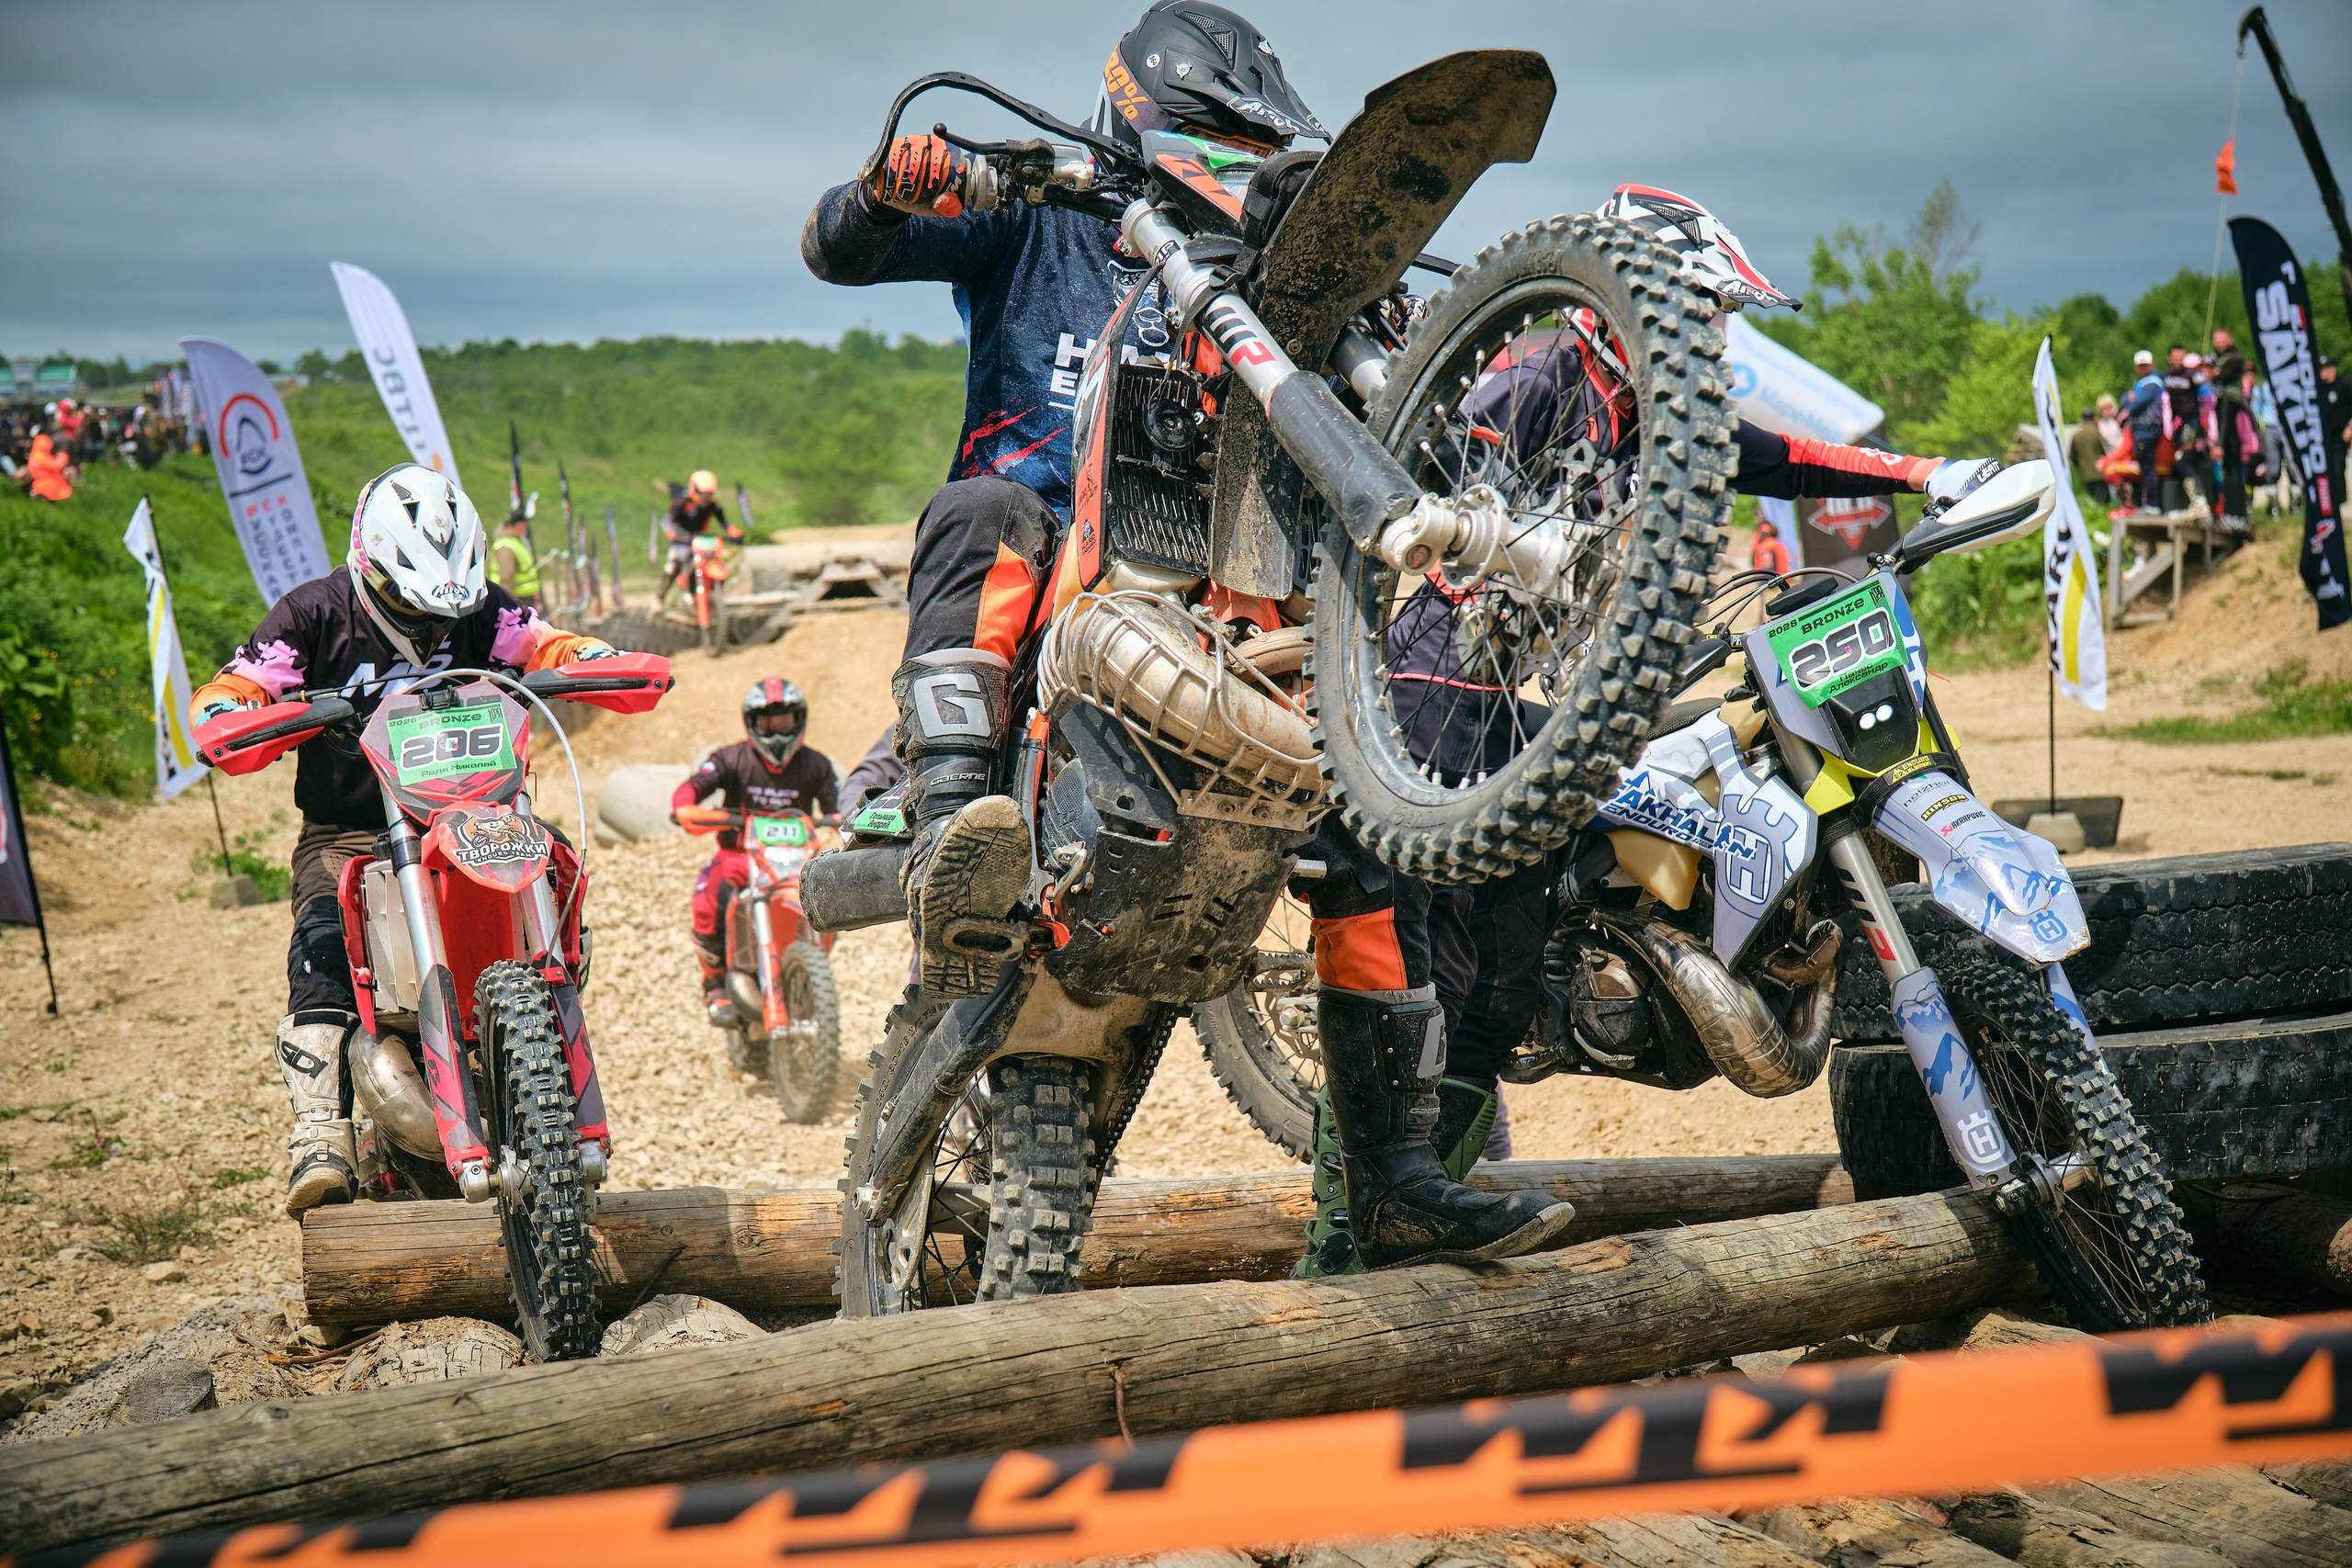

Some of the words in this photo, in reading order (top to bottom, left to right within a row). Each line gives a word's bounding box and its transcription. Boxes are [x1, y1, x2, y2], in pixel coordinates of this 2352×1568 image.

[1105, 51, 1150, 120] 00%
[1801, 597, 1866, 635] BRONZE
[1789, 607, 1896, 692] 250
[1828, 661, 1889, 694] Александр
[419, 714, 482, 730] BRONZE
[400, 723, 503, 771] 206
[421, 765, 449, 777] Рада
[451, 761, 497, 772] Николай
[1602, 803, 1692, 841] ENDURO
[1921, 794, 1969, 822] HINSON
[459, 841, 549, 863] ТВОРОЖКИ
[477, 851, 508, 863] ENDURO
[511, 850, 533, 859] TEAM
